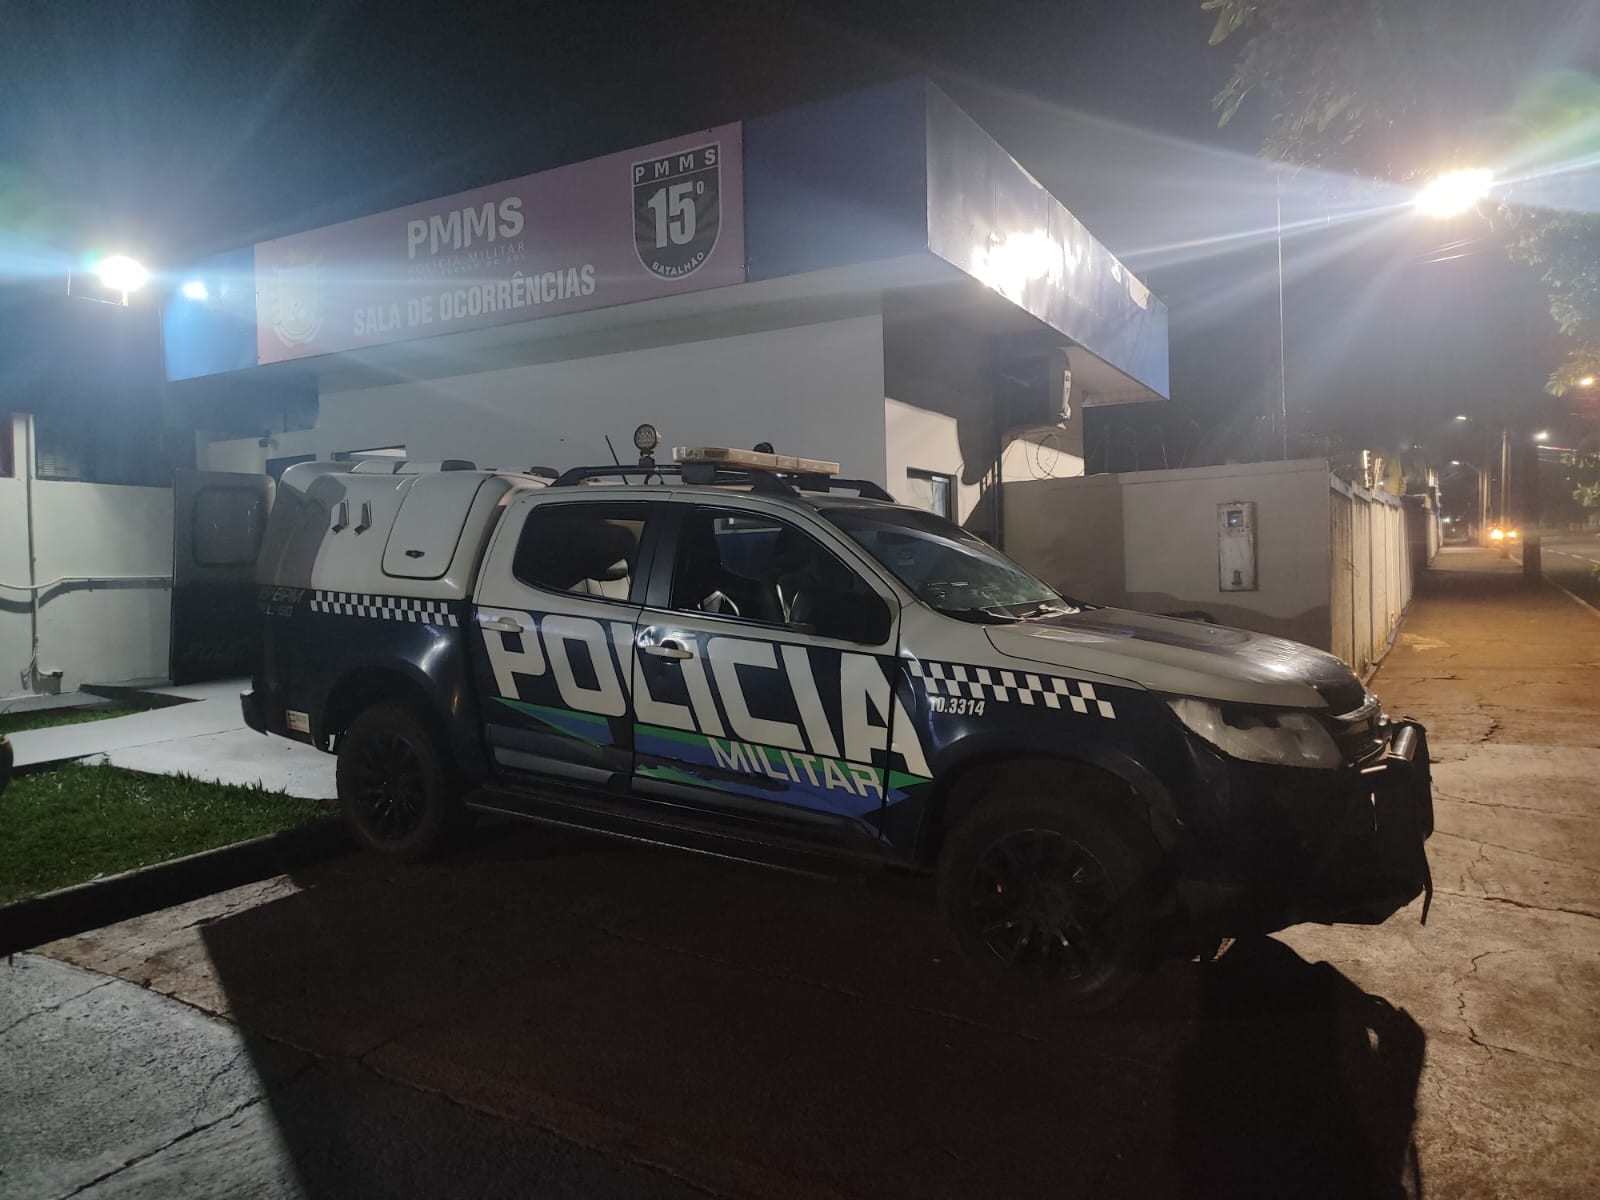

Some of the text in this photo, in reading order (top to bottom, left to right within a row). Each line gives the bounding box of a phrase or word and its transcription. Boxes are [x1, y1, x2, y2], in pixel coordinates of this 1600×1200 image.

[635, 149, 716, 182] PMMS
[407, 197, 524, 259] PMMS
[652, 252, 704, 275] BATALHÃO
[354, 303, 401, 336] SALA
[407, 296, 433, 327] DE
[439, 264, 595, 321] OCORRÊNCIAS
[476, 608, 934, 780] POLICIA
[928, 696, 986, 717] 10.3314
[707, 737, 890, 802] MILITAR
